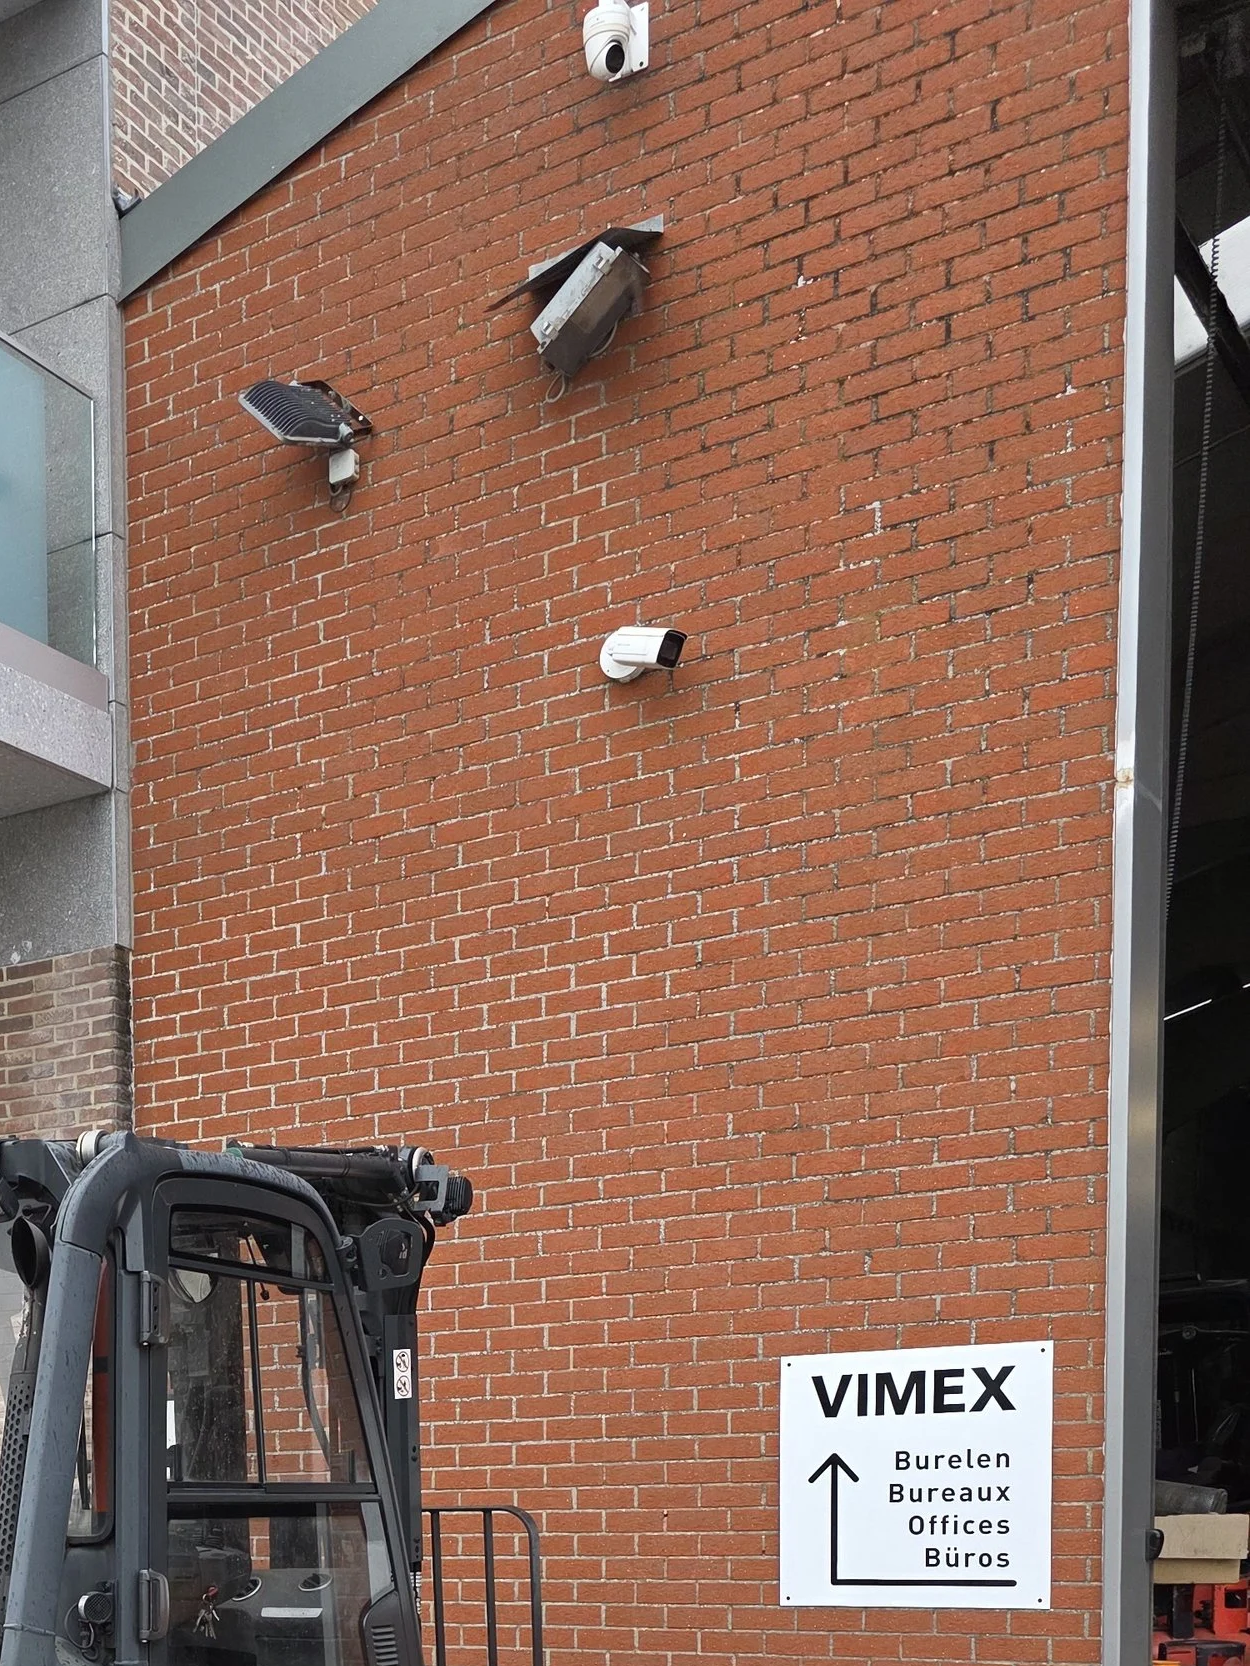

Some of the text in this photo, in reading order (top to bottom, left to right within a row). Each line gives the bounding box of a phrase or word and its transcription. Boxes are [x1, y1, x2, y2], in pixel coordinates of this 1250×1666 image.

[811, 1365, 1017, 1418] VIMEX
[895, 1448, 1010, 1471] Burelen
[889, 1483, 1010, 1503] Bureaux
[908, 1514, 1010, 1536] Offices
[925, 1546, 1010, 1568] Büros
